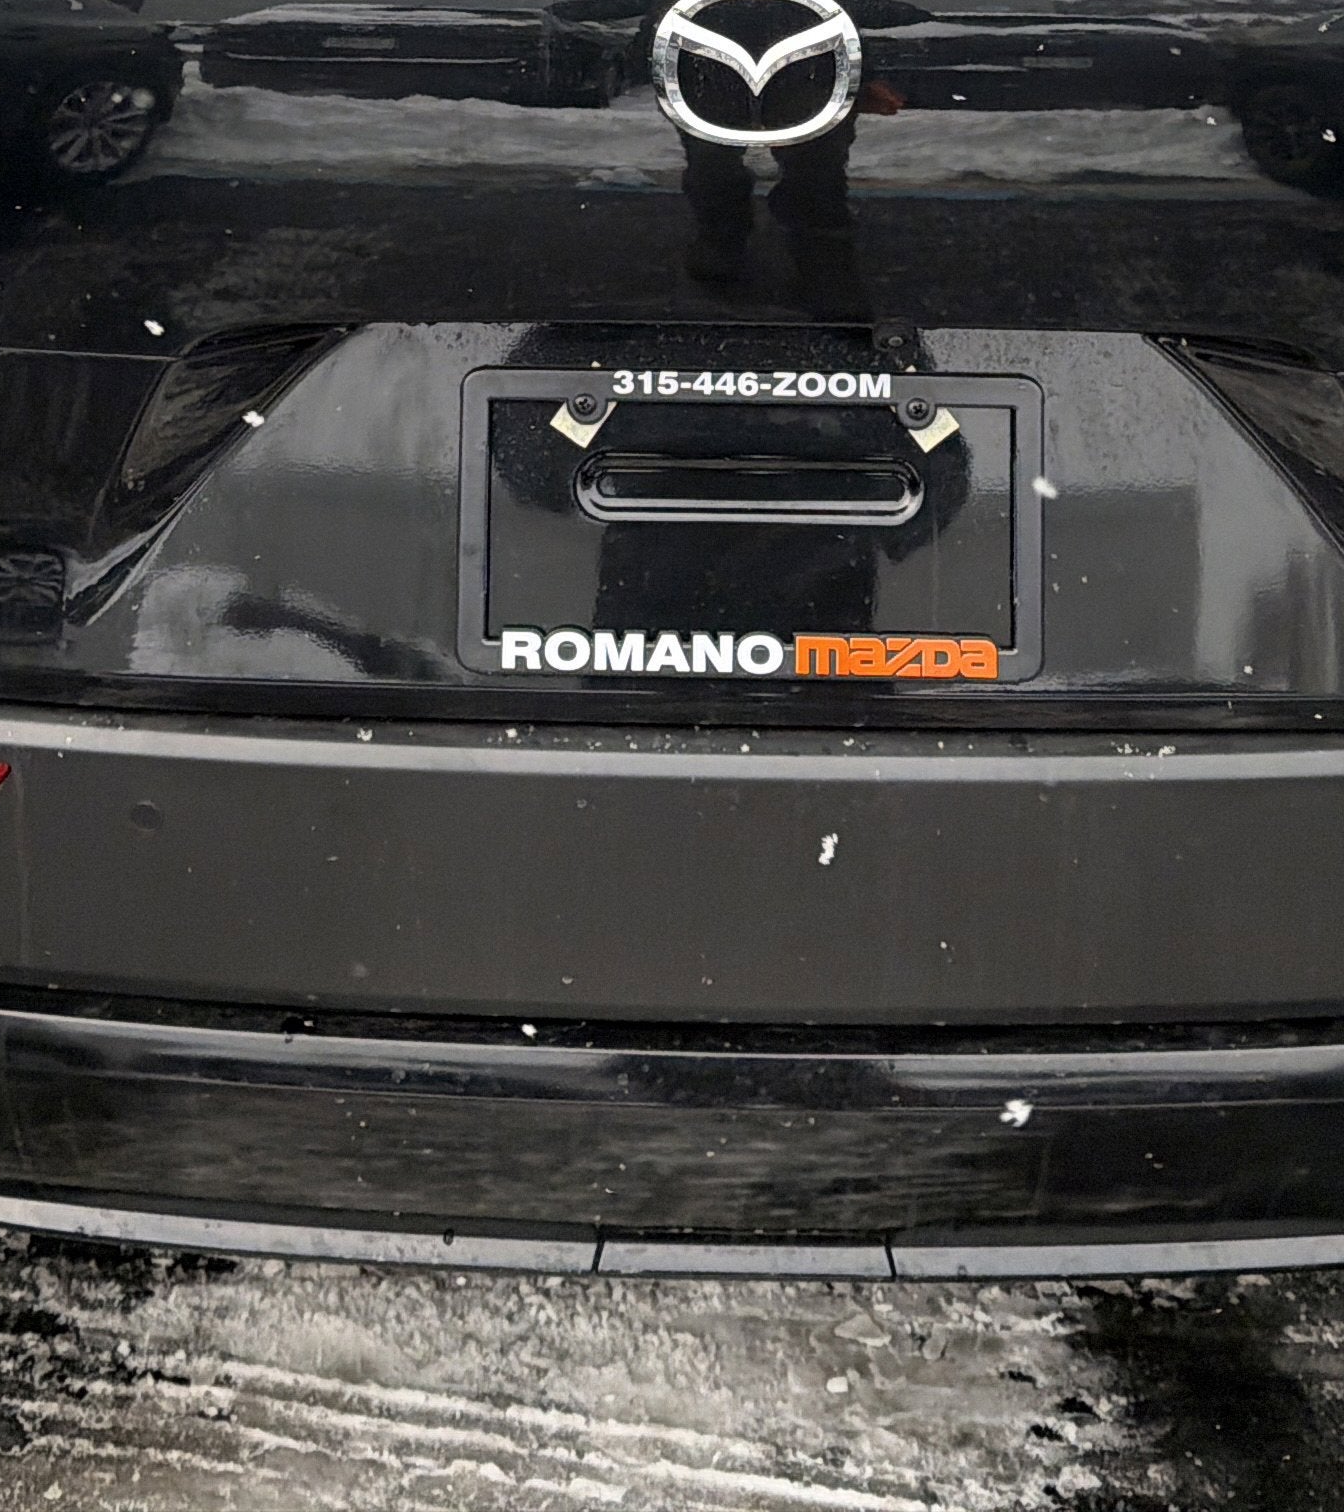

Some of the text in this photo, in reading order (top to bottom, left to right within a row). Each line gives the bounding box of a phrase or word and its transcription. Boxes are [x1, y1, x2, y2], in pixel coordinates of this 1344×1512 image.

[612, 370, 892, 399] 315-446-ZOOM
[501, 630, 999, 679] ROMANO mazda
